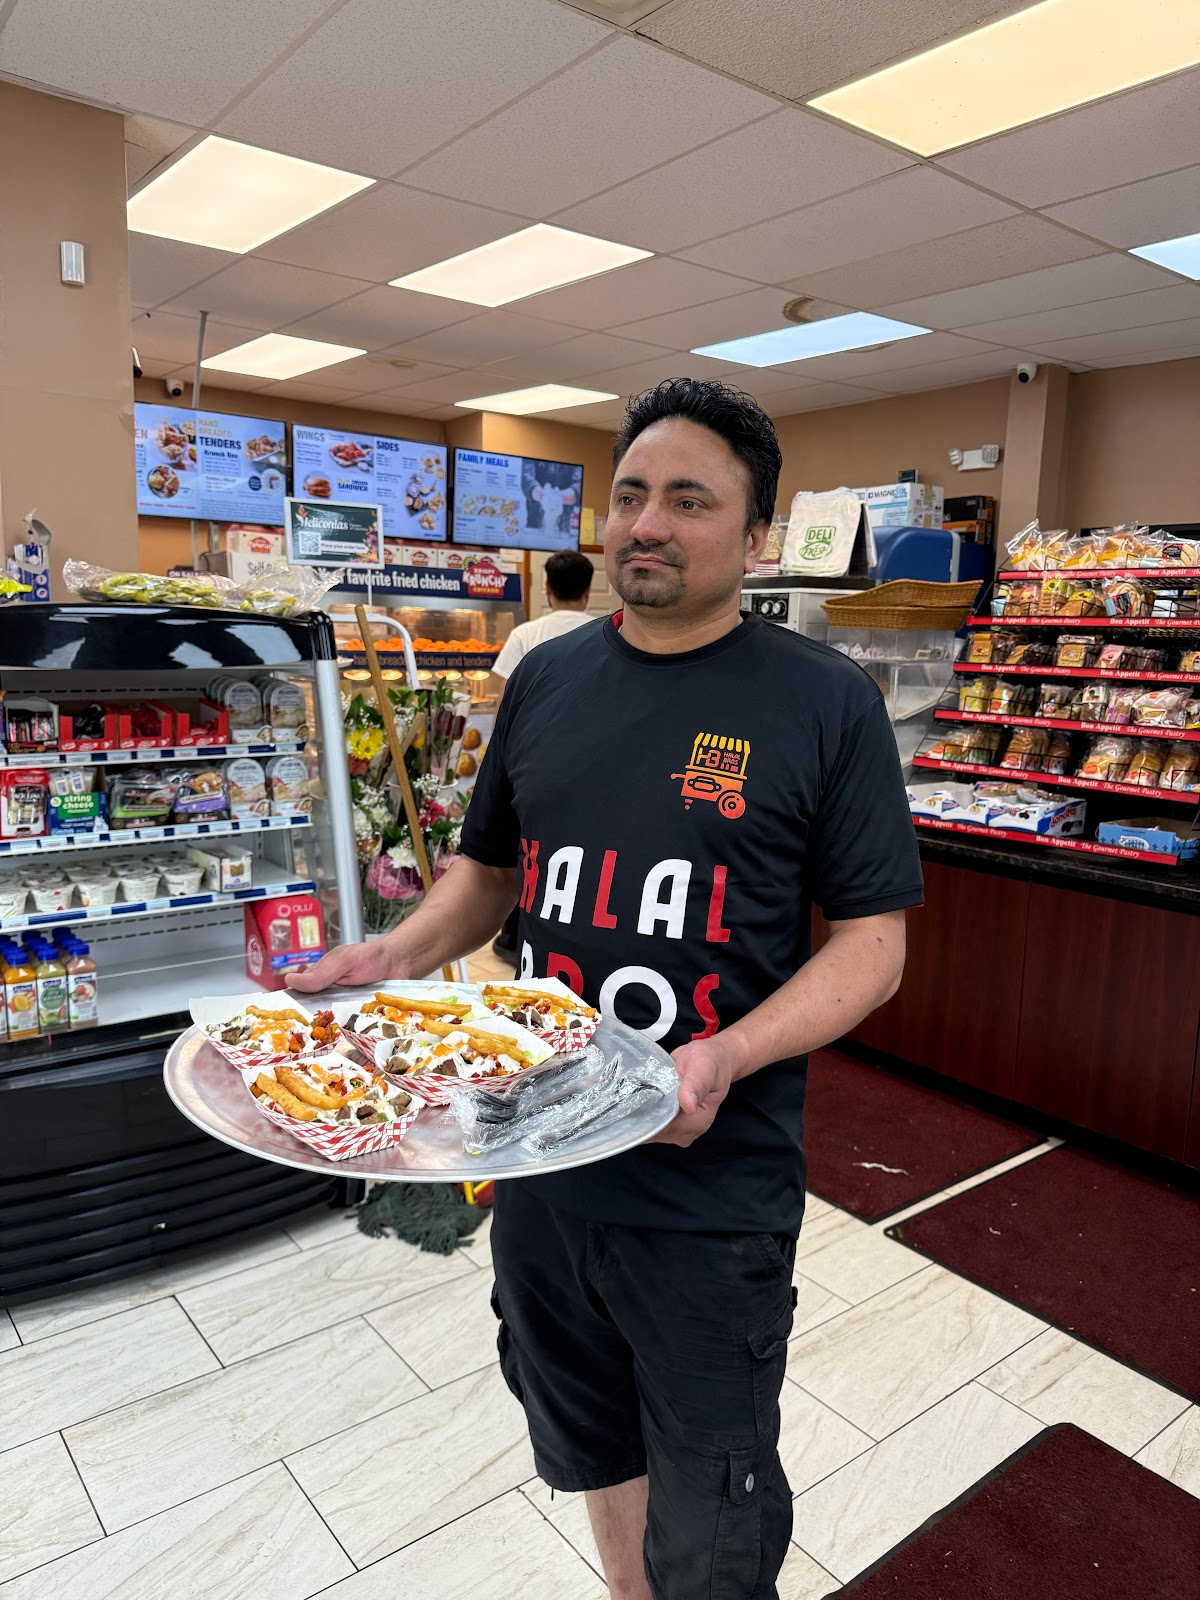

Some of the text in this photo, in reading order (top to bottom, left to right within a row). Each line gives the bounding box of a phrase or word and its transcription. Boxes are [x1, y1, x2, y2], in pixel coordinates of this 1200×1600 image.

[296, 429, 325, 442] WINGS
[199, 436, 242, 450] TENDERS
[376, 440, 400, 452] SIDES
[458, 453, 510, 468] FAMILY MEALS
[808, 529, 832, 540] DELI
[1099, 570, 1116, 578] Pastry
[1161, 569, 1187, 577] Appetit
[346, 568, 392, 587] favorite
[392, 570, 418, 590] fried
[420, 573, 461, 592] chicken
[462, 570, 508, 588] KRUNCHY
[472, 586, 500, 594] CHICKEN
[1064, 618, 1081, 626] Pastry
[1124, 618, 1150, 626] Appetit
[1167, 619, 1193, 627] Gourmet
[448, 654, 463, 667] and
[464, 655, 493, 668] tenders
[1053, 668, 1071, 676] Pastry
[1114, 670, 1140, 678] Appetit
[1157, 673, 1183, 681] Gourmet
[974, 713, 997, 722] Appetit
[1010, 716, 1033, 724] Gourmet
[1034, 718, 1052, 727] Pastry
[1095, 723, 1121, 732] Appetit
[1138, 728, 1163, 736] Gourmet
[1165, 730, 1186, 739] Pastry
[952, 762, 974, 771] Appetit
[989, 767, 1010, 776] Gourmet
[1012, 770, 1029, 780] Pastry
[1058, 776, 1098, 788] Bon Appetit
[1115, 783, 1140, 793] Gourmet
[1142, 786, 1162, 797] Pastry
[64, 794, 93, 803] string
[62, 802, 94, 810] cheese
[931, 819, 953, 829] Appetit
[957, 822, 1007, 838] The Gourmet Pastry
[1036, 834, 1076, 848] Bon Appetit
[1080, 842, 1140, 859] The Gourmet Pastry
[519, 837, 731, 943] HALAL
